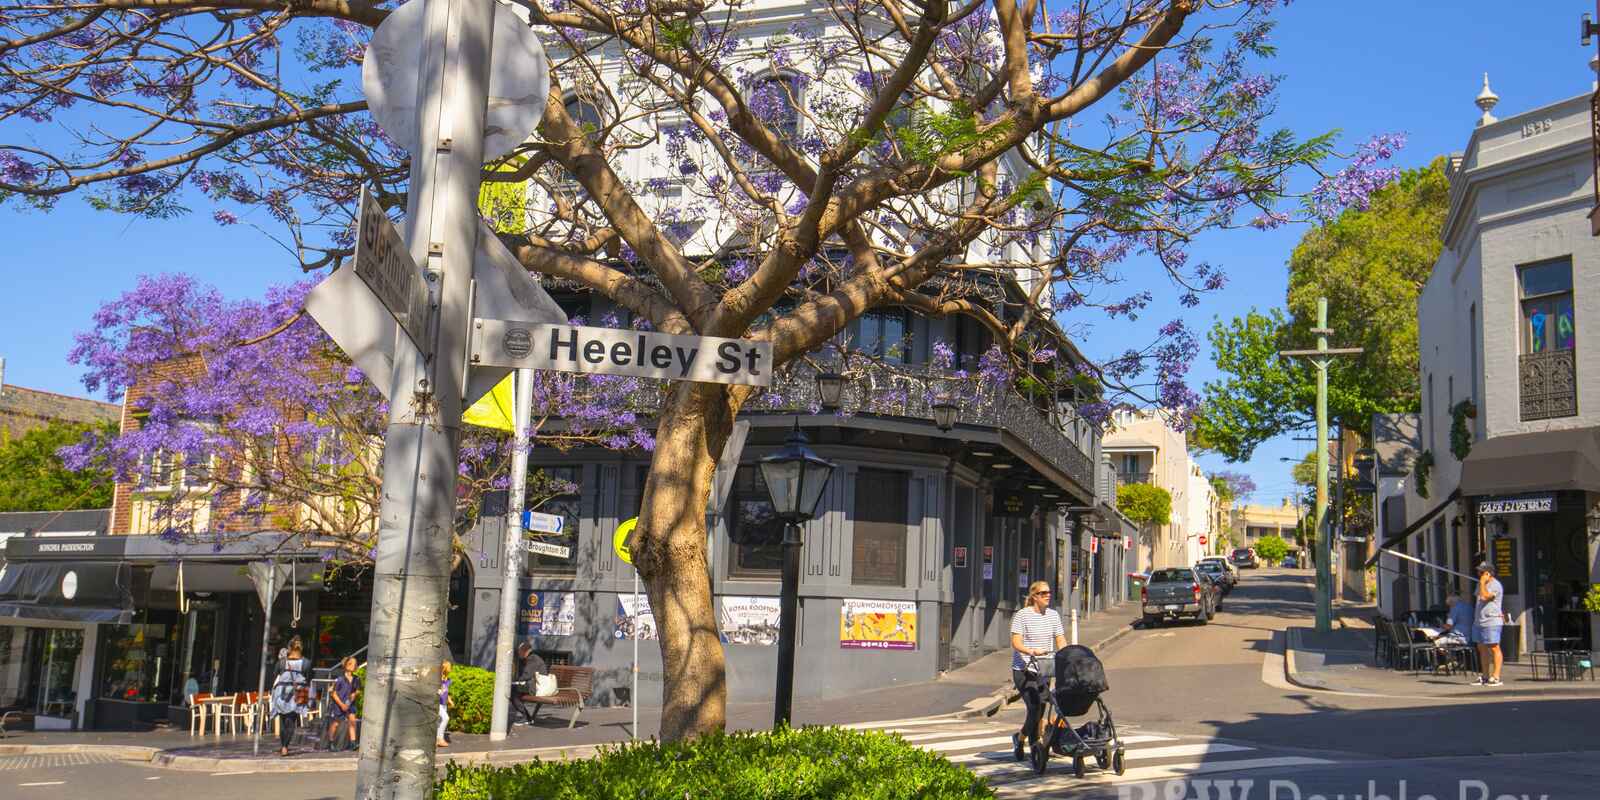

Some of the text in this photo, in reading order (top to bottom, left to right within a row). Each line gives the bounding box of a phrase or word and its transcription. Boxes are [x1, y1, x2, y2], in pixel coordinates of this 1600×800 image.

[365, 206, 412, 299] Glenmor
[550, 328, 699, 378] Heeley
[715, 341, 761, 376] St
[560, 545, 567, 556] St
[521, 609, 543, 617] DAILY
